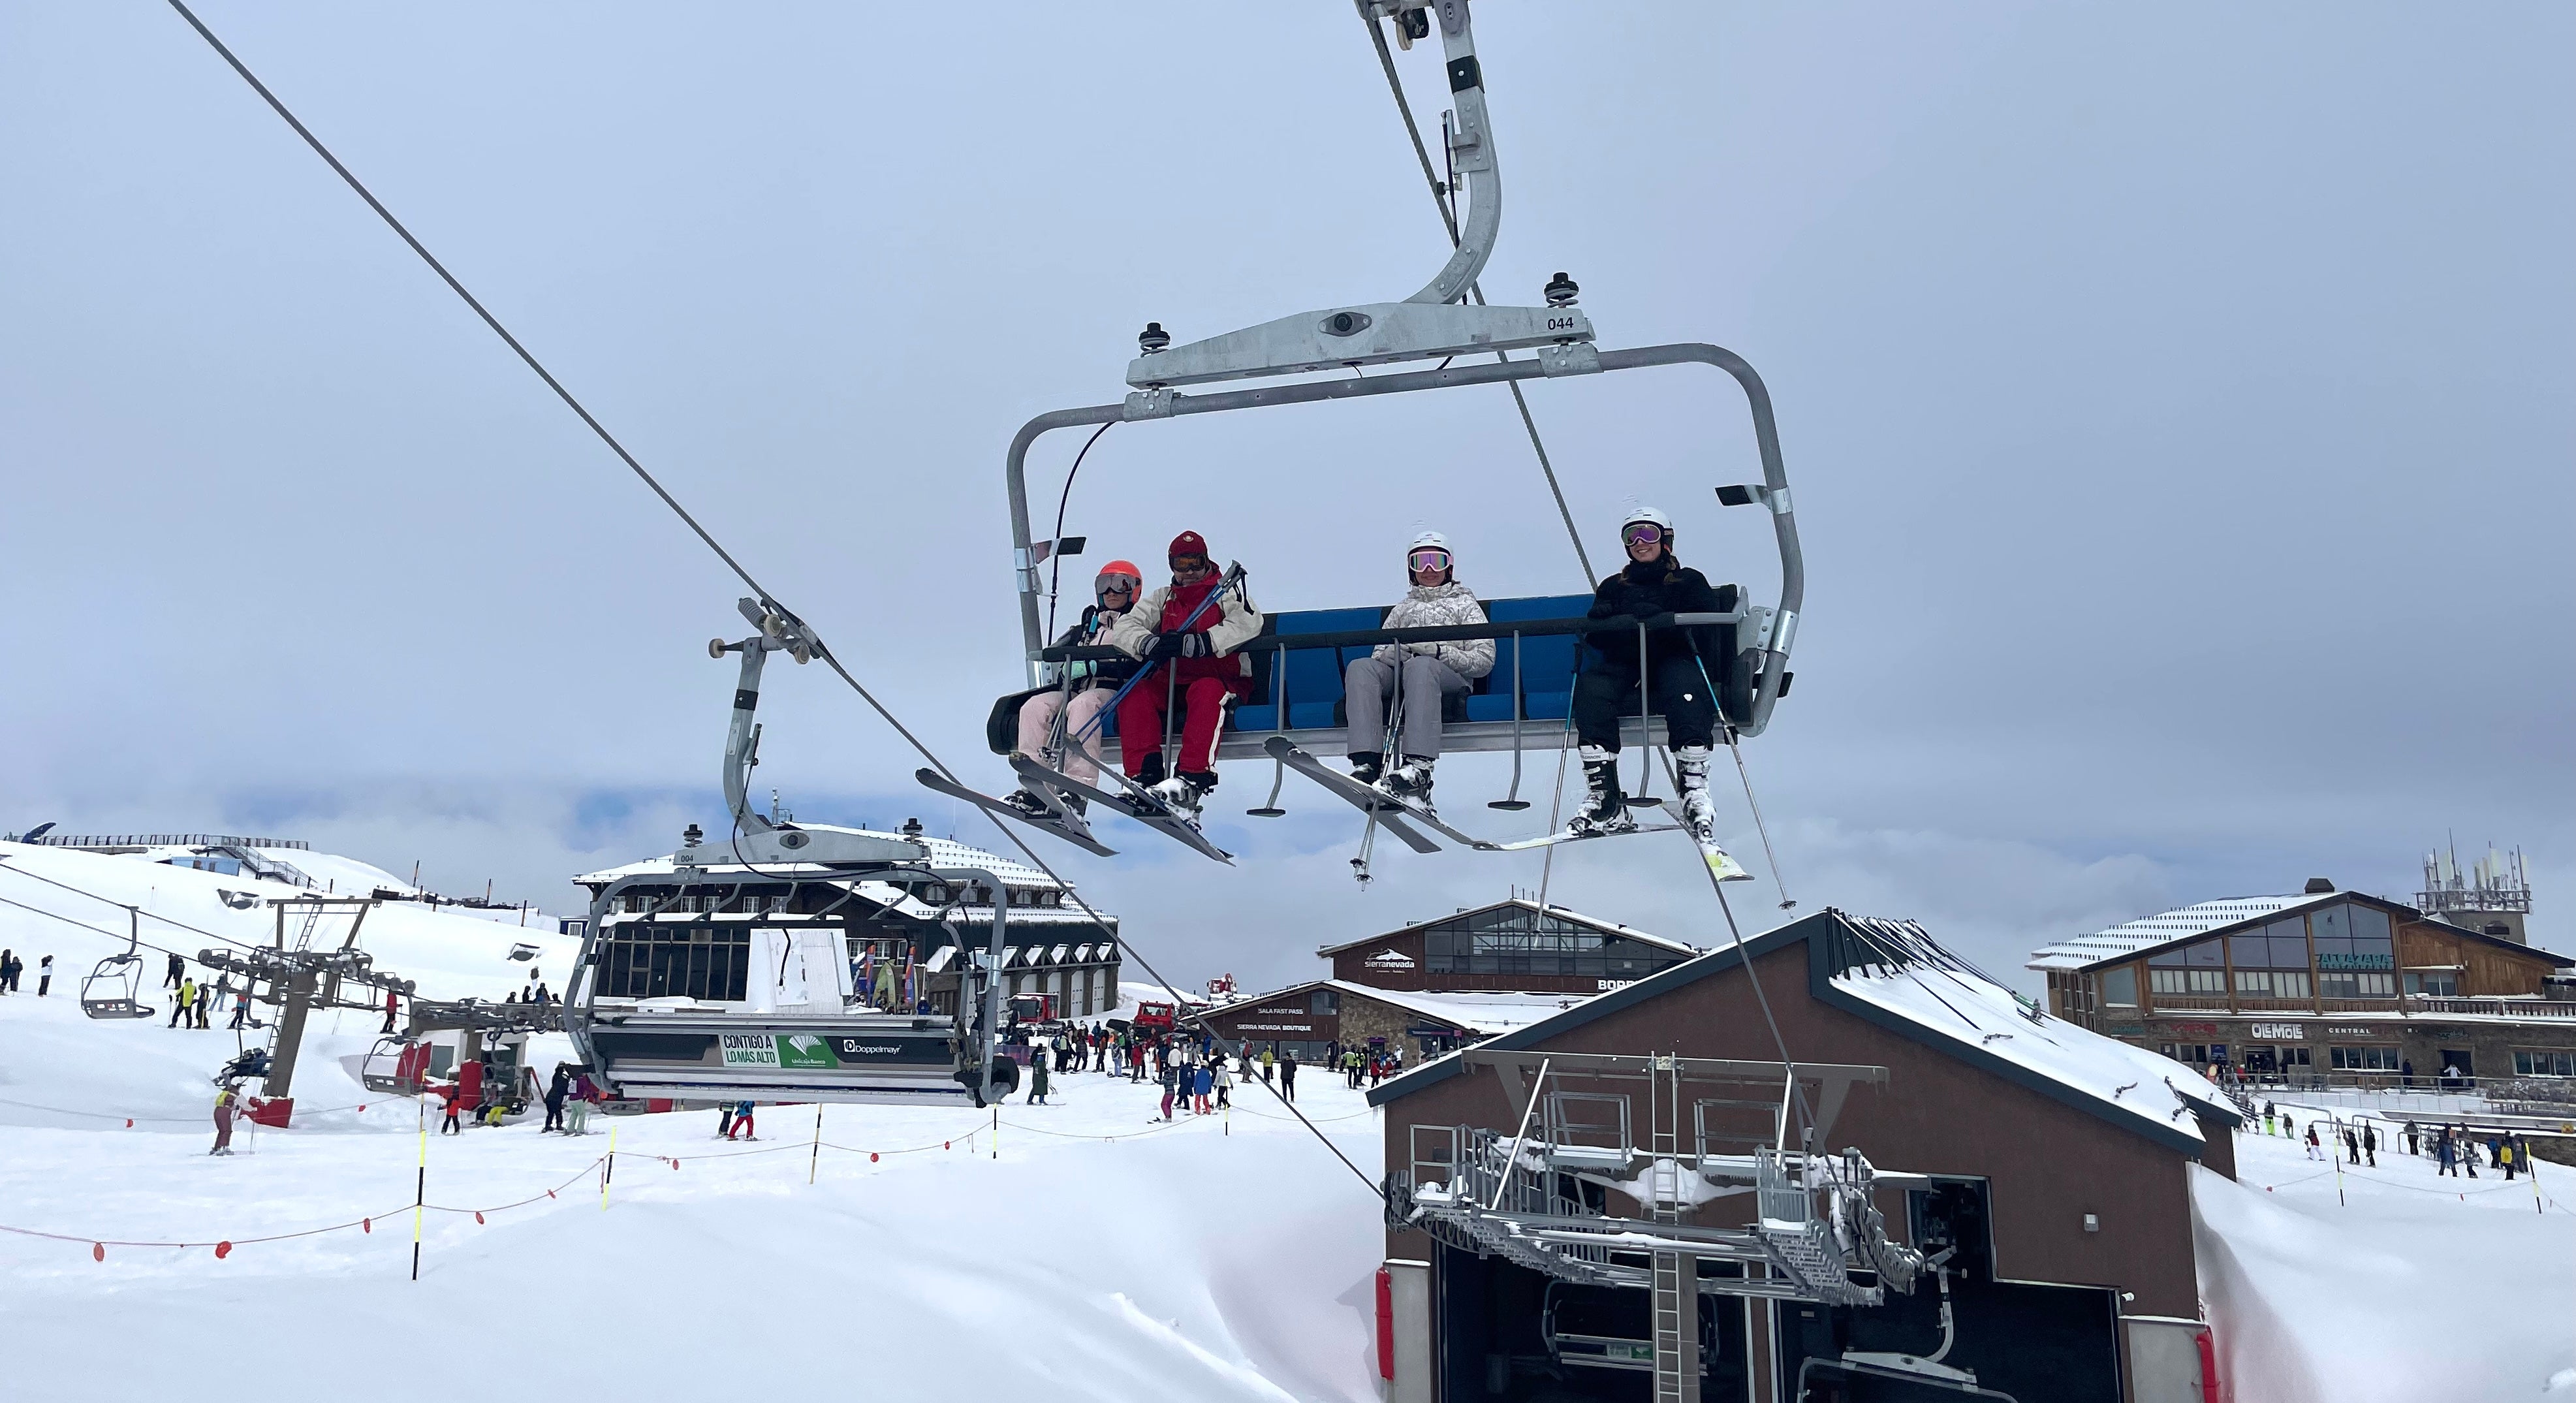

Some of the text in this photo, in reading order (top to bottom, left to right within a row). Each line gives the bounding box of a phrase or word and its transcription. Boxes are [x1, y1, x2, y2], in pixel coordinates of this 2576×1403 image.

[1548, 317, 1574, 330] 044
[723, 1035, 773, 1048] CONTIGO A
[856, 1045, 900, 1054] Doppelmayr
[727, 1051, 738, 1062] LO
[756, 1052, 776, 1063] ALTO
